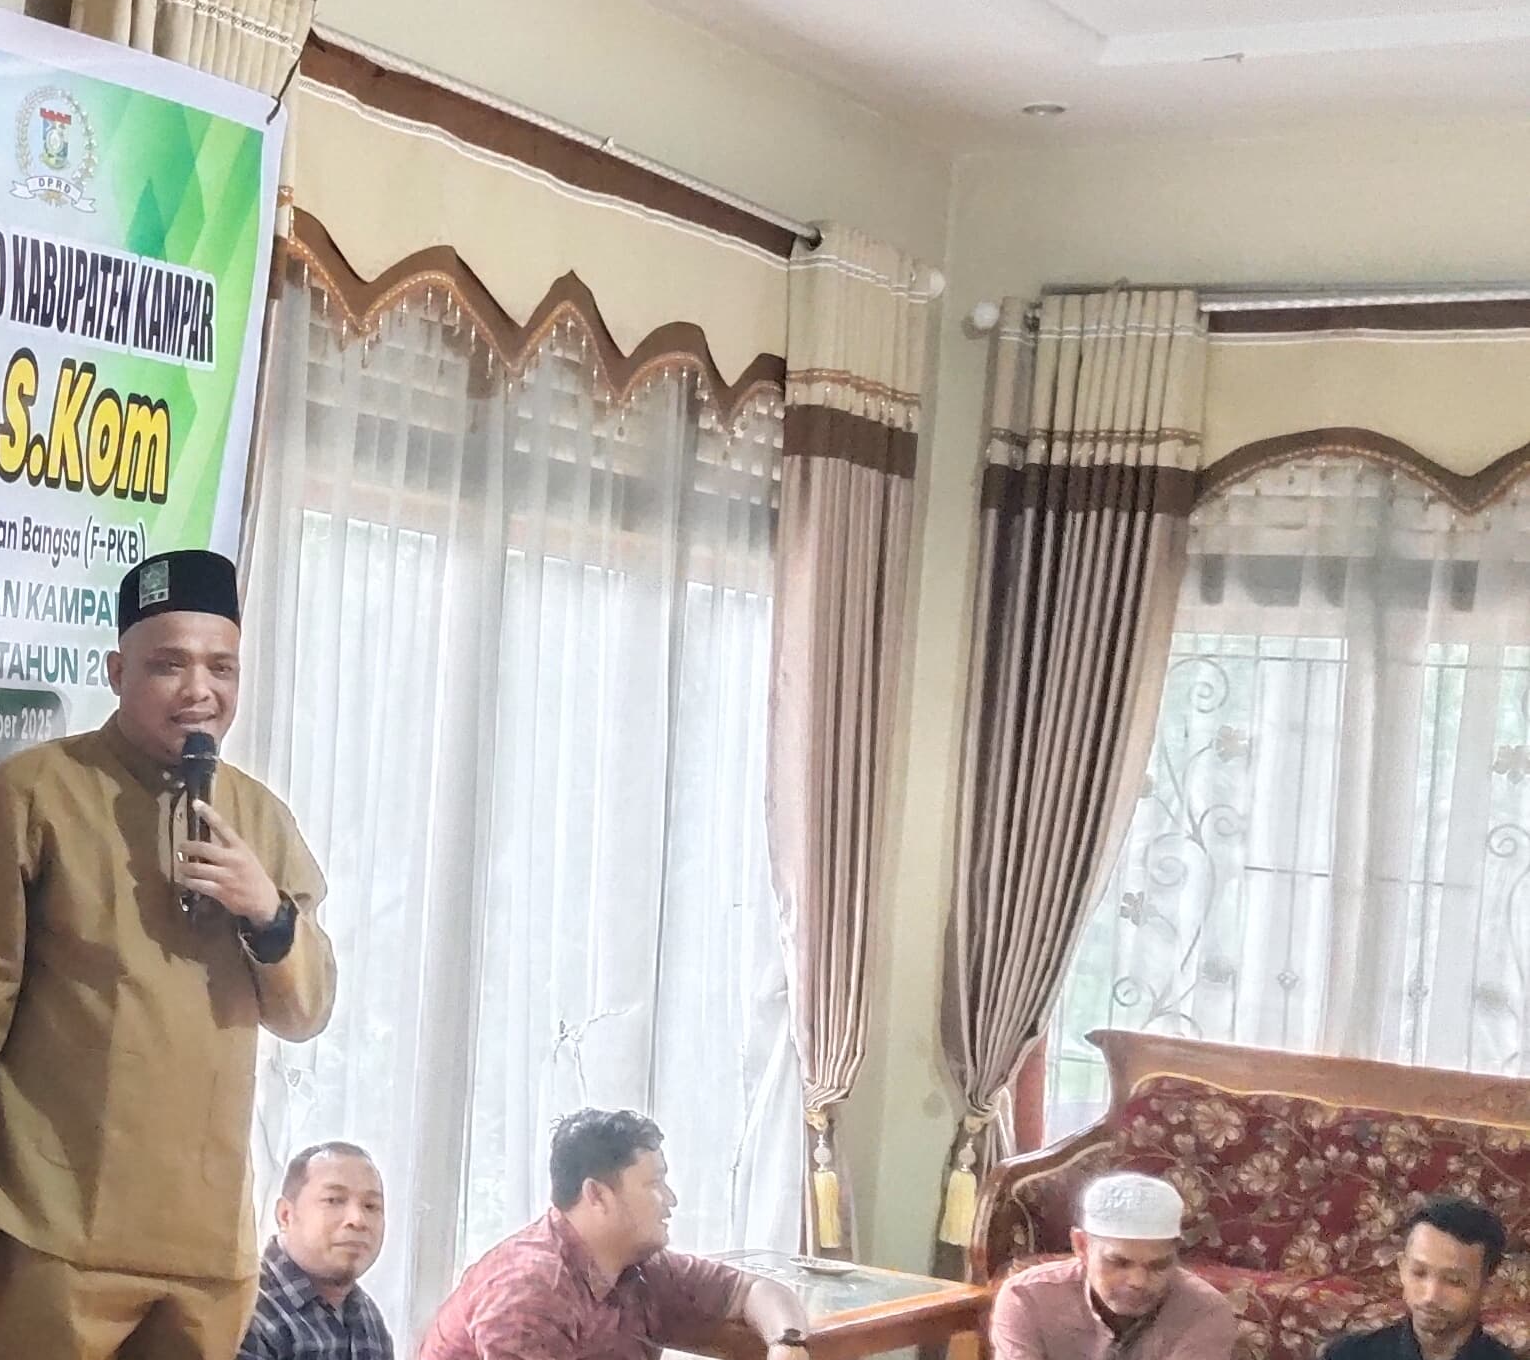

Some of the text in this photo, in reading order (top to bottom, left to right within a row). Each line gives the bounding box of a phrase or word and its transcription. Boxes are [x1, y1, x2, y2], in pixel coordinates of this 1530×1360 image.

[38, 177, 71, 194] DPRD
[10, 234, 137, 345] KABUPATEN
[133, 263, 214, 363] KAMPAR
[21, 516, 81, 568] Bangsa
[84, 516, 146, 569] (F-PKB)
[25, 582, 119, 627] KAMPA
[21, 707, 53, 740] 2025
